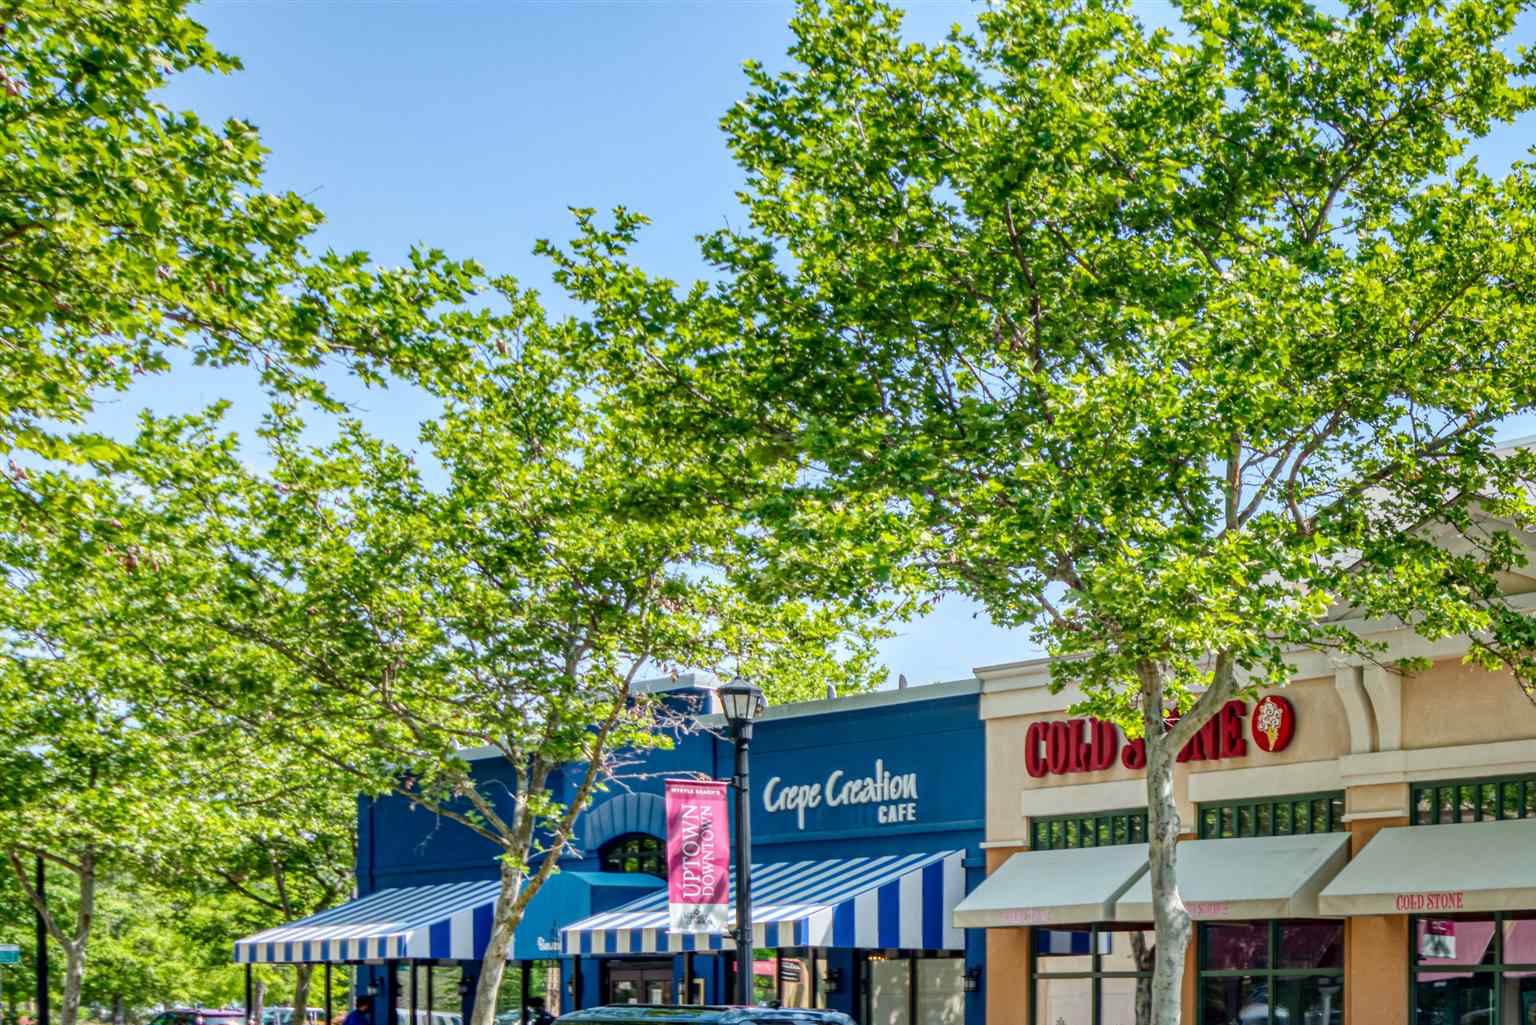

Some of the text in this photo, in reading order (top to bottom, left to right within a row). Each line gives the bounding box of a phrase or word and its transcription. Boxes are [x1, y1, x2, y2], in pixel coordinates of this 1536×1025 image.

[1024, 716, 1118, 778] COLD
[763, 758, 918, 830] Crepe Creation
[878, 803, 917, 824] CAFE
[680, 804, 701, 898] UPTOWN
[700, 805, 715, 897] DOWNTOWN
[1396, 892, 1463, 910] COLD STONE
